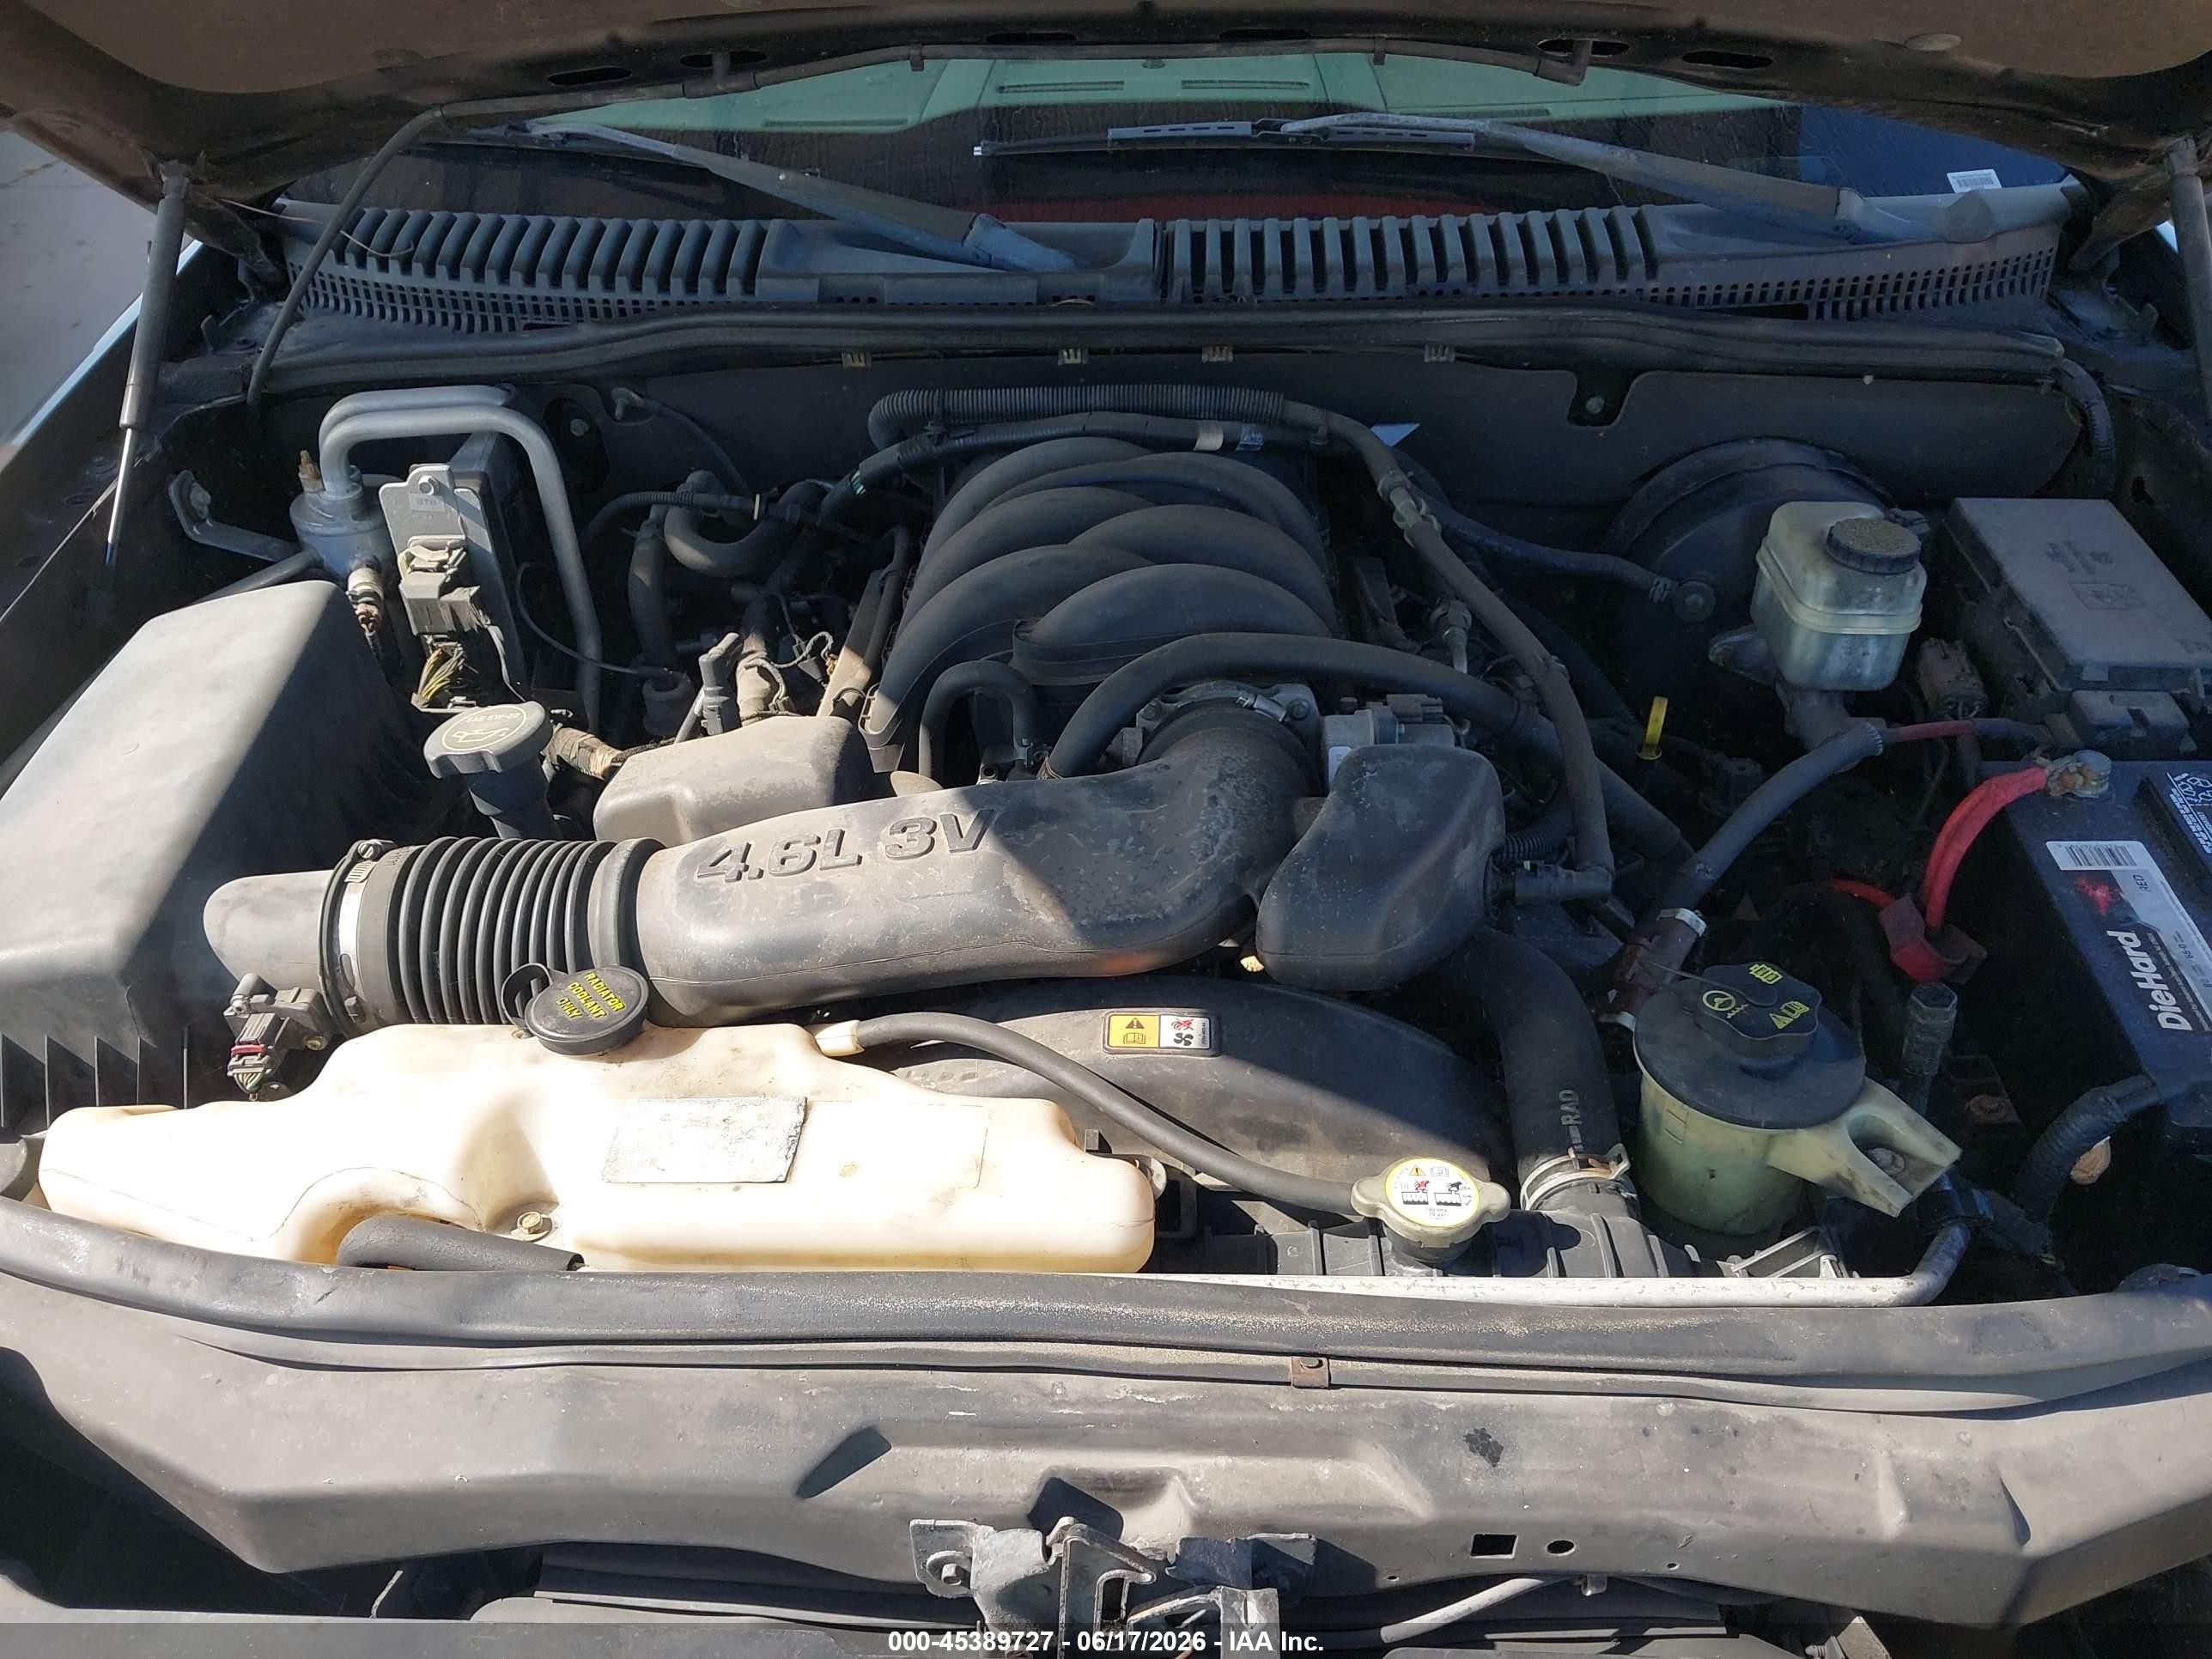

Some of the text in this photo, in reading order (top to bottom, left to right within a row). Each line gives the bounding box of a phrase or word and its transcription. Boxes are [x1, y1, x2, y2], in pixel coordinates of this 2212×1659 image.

[696, 808, 998, 884] 4.6L 3V
[568, 981, 607, 1018] COOLANT
[584, 970, 626, 1012] RADIATOR
[2106, 929, 2193, 1031] DieHard
[556, 997, 583, 1019] ONLY
